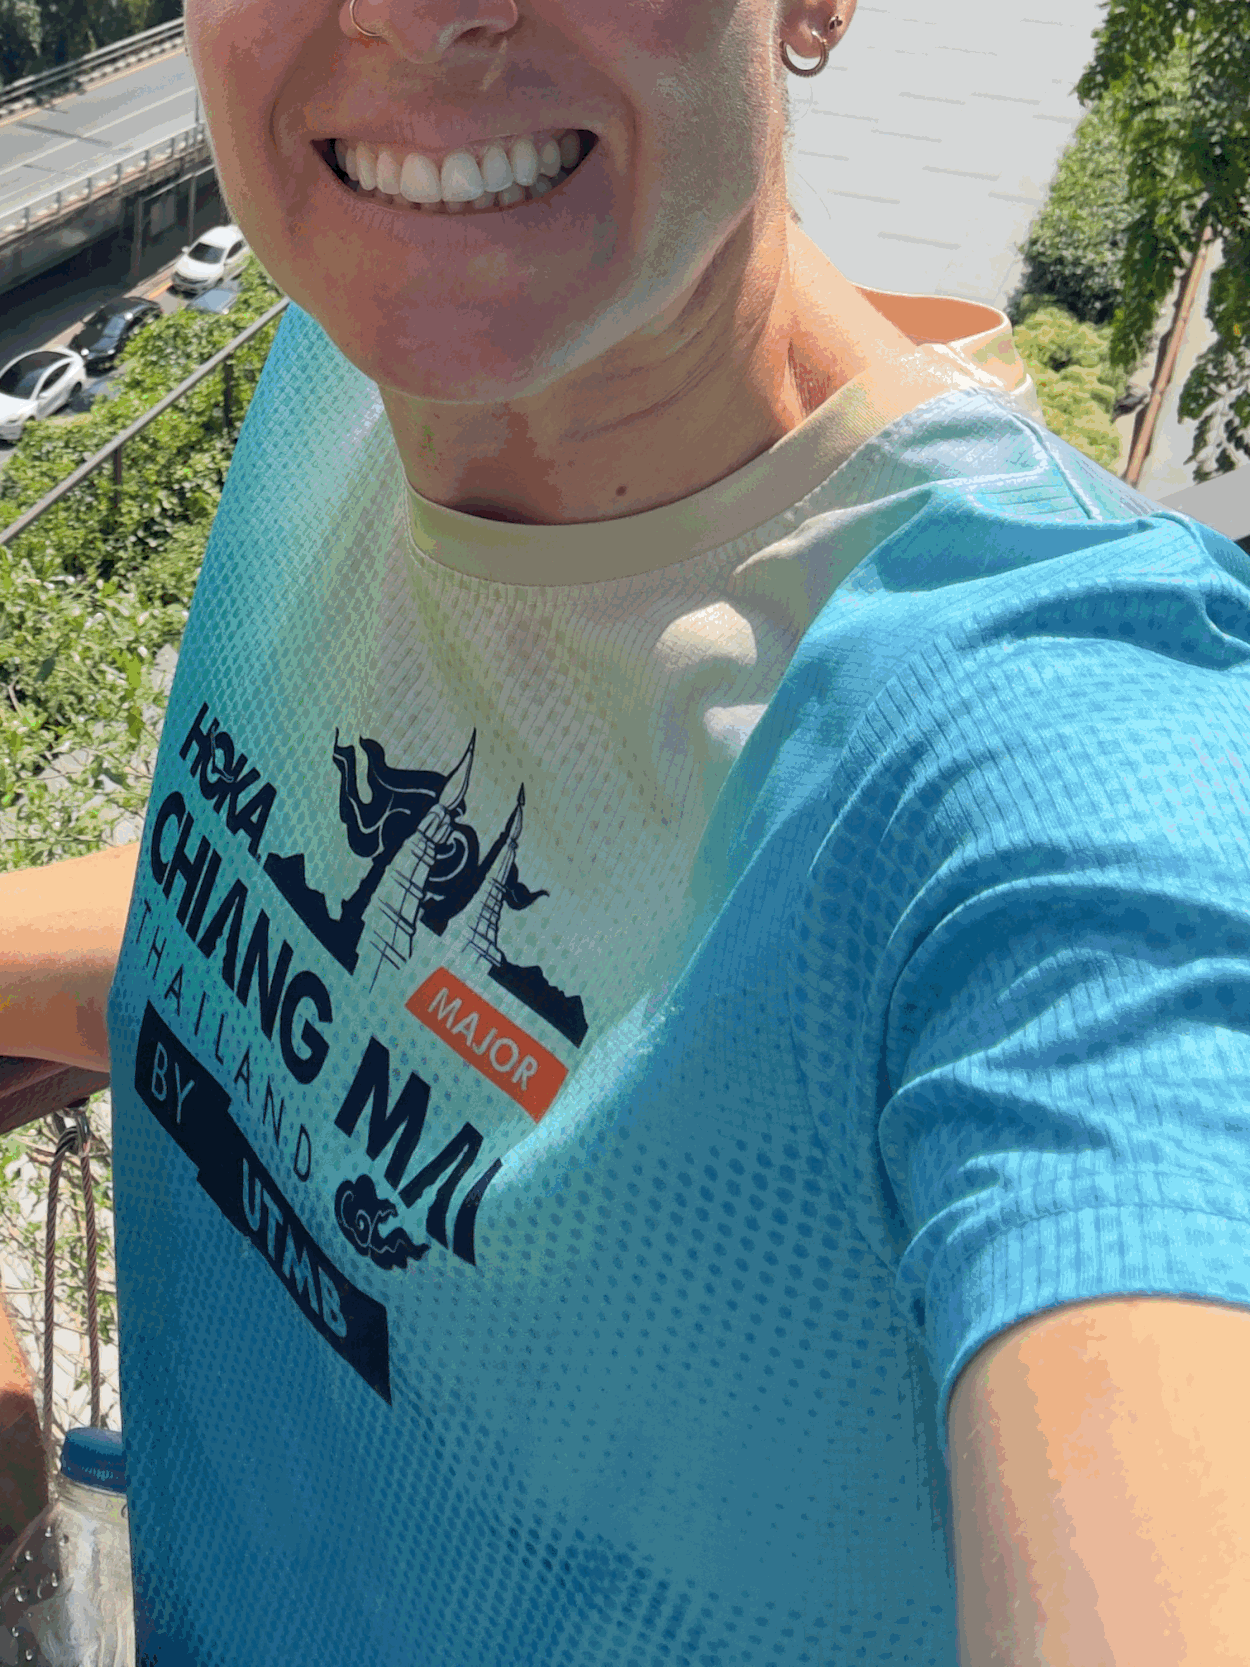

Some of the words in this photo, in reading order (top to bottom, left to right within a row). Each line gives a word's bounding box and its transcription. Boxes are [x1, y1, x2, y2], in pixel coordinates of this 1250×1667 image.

[178, 701, 277, 860] HOKA
[136, 898, 311, 1183] THAILAND
[151, 790, 334, 1085] CHIANG
[426, 986, 539, 1092] MAJOR
[151, 1040, 196, 1126] BY
[241, 1157, 349, 1339] UTMB
